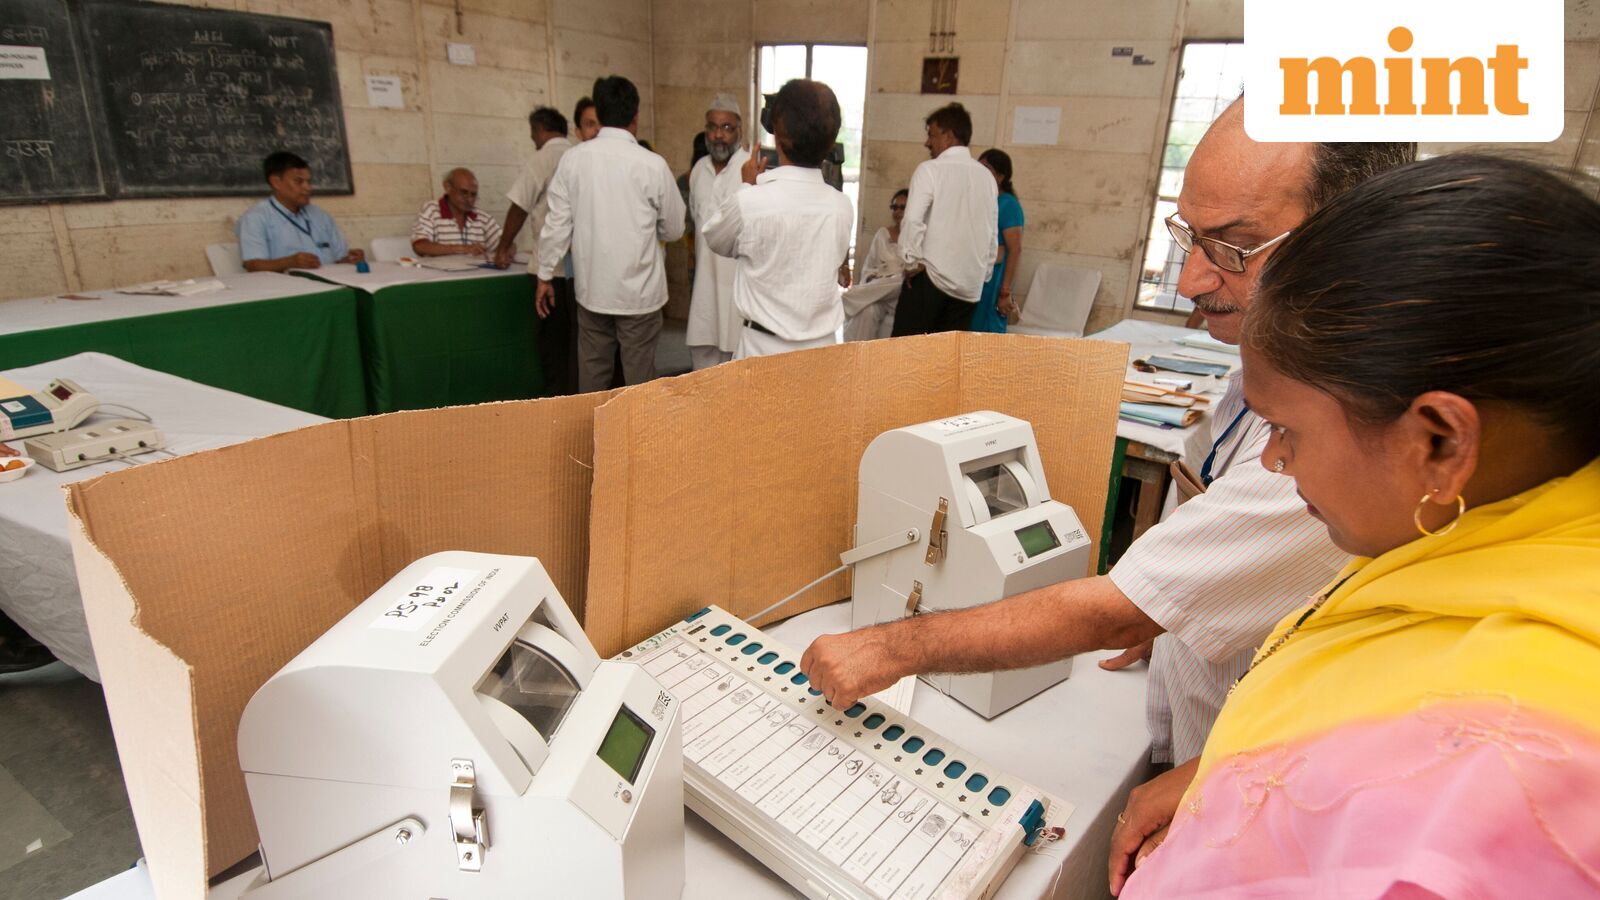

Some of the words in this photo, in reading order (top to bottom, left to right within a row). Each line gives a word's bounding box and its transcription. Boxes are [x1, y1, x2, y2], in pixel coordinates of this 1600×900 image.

[268, 34, 301, 50] NIFT
[419, 618, 451, 647] ELECTION
[447, 586, 481, 619] COMMISSION
[486, 568, 501, 580] INDIA
[493, 612, 511, 633] VVPAT
